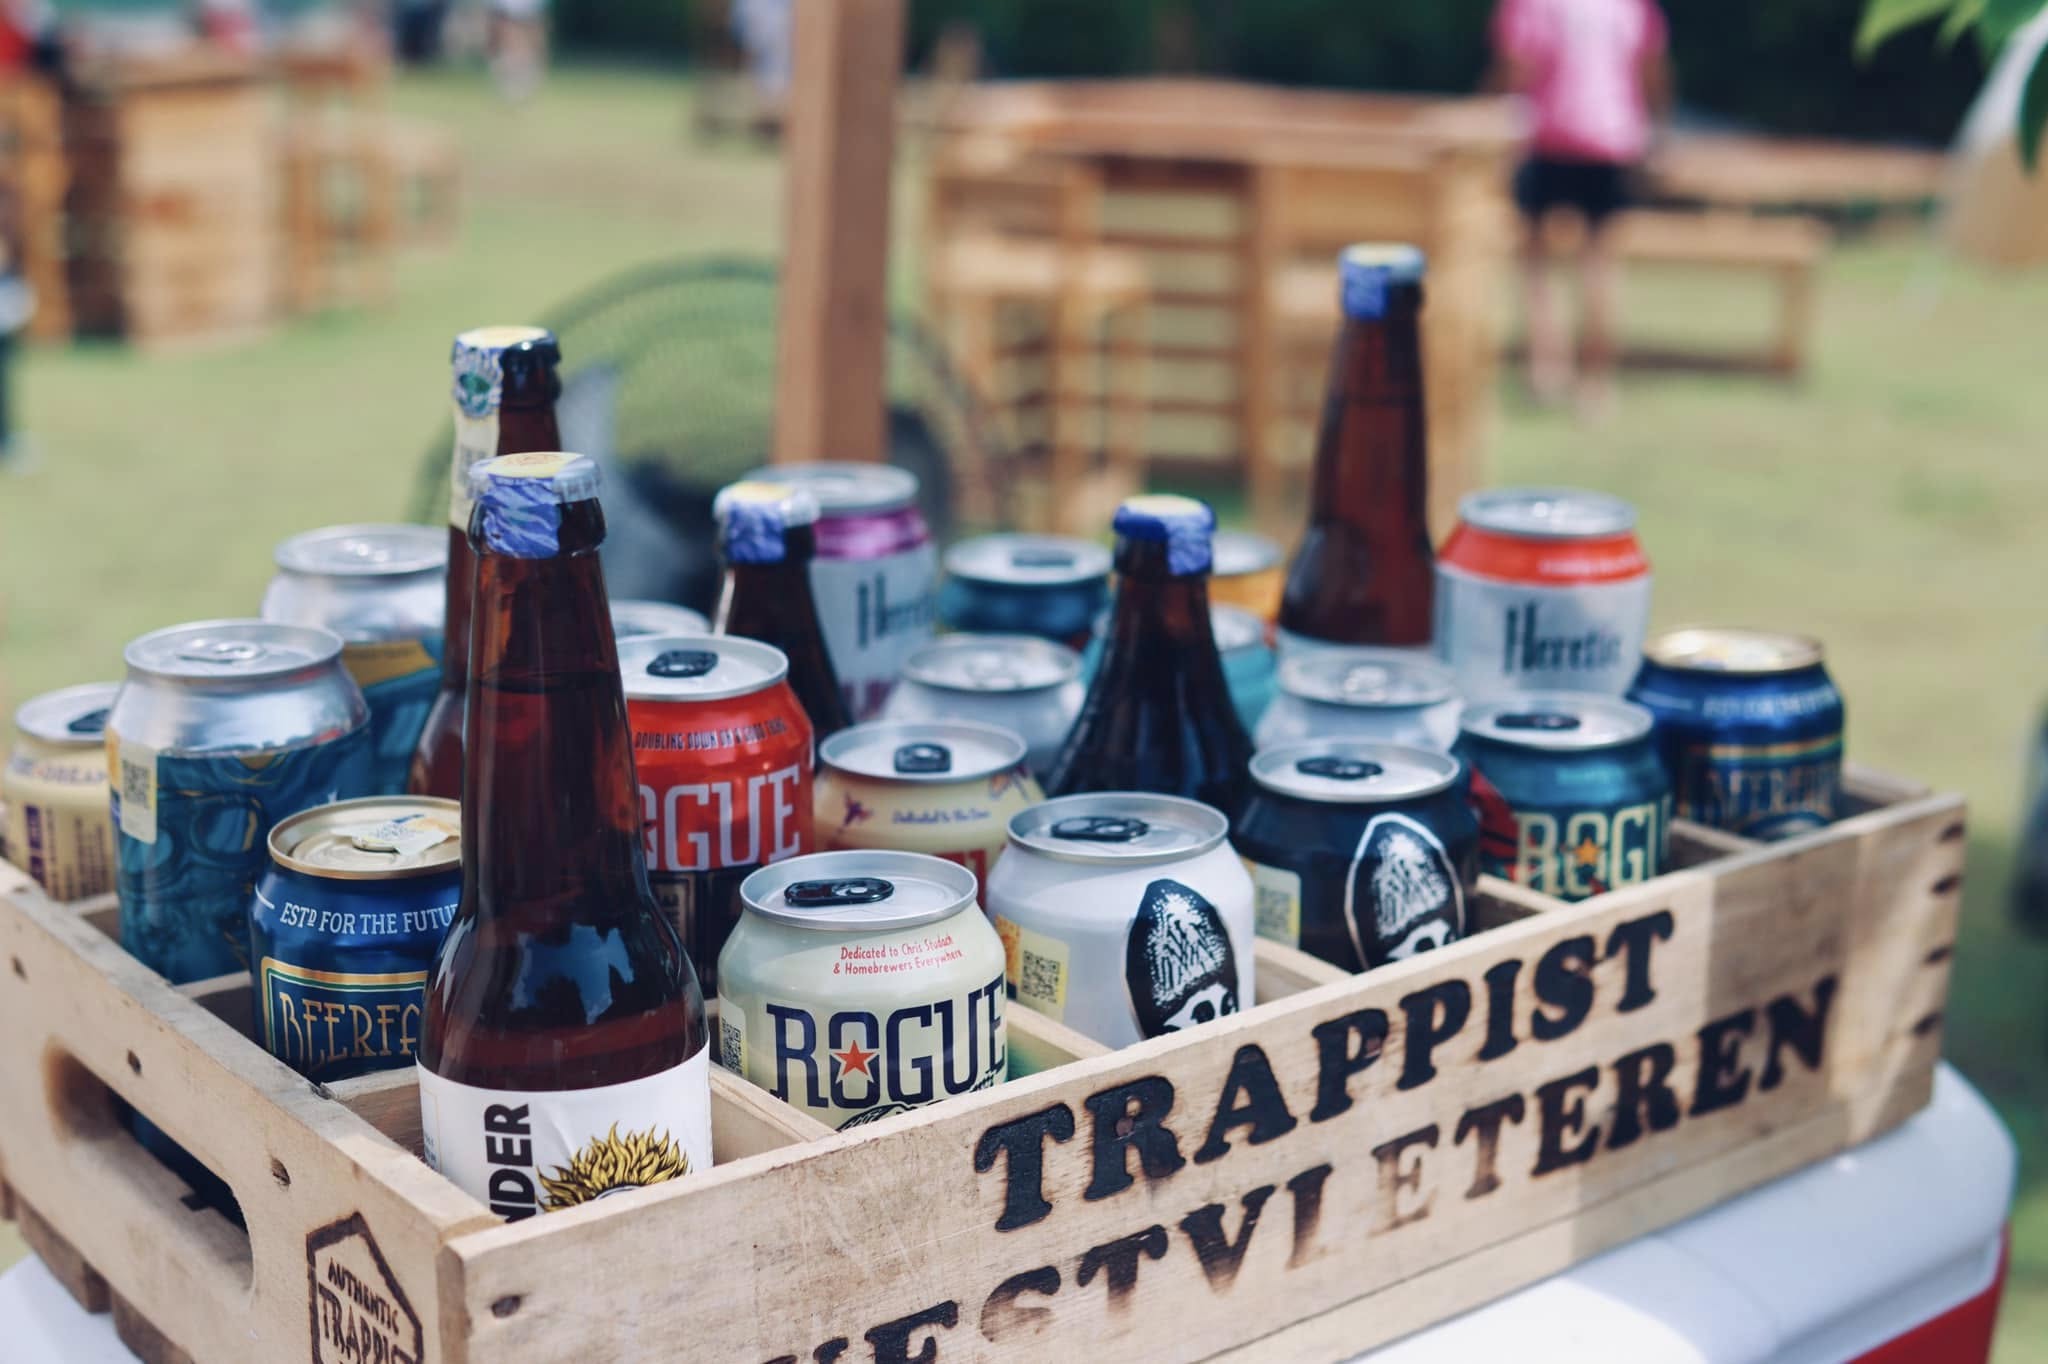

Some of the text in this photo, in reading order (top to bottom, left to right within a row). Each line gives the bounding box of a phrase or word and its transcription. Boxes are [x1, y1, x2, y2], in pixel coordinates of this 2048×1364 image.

[635, 731, 684, 749] DOUBLING
[687, 730, 718, 749] DOWN
[318, 912, 356, 935] FOR
[360, 913, 398, 935] THE
[840, 944, 887, 960] Dedicated
[889, 946, 899, 957] to
[902, 942, 923, 956] Chris
[833, 962, 841, 975] &
[845, 961, 913, 976] Homebrewers
[766, 971, 1007, 1109] ROGUE
[975, 909, 1675, 1233] TRAPPIST
[328, 1256, 399, 1336] AUTHENTIC
